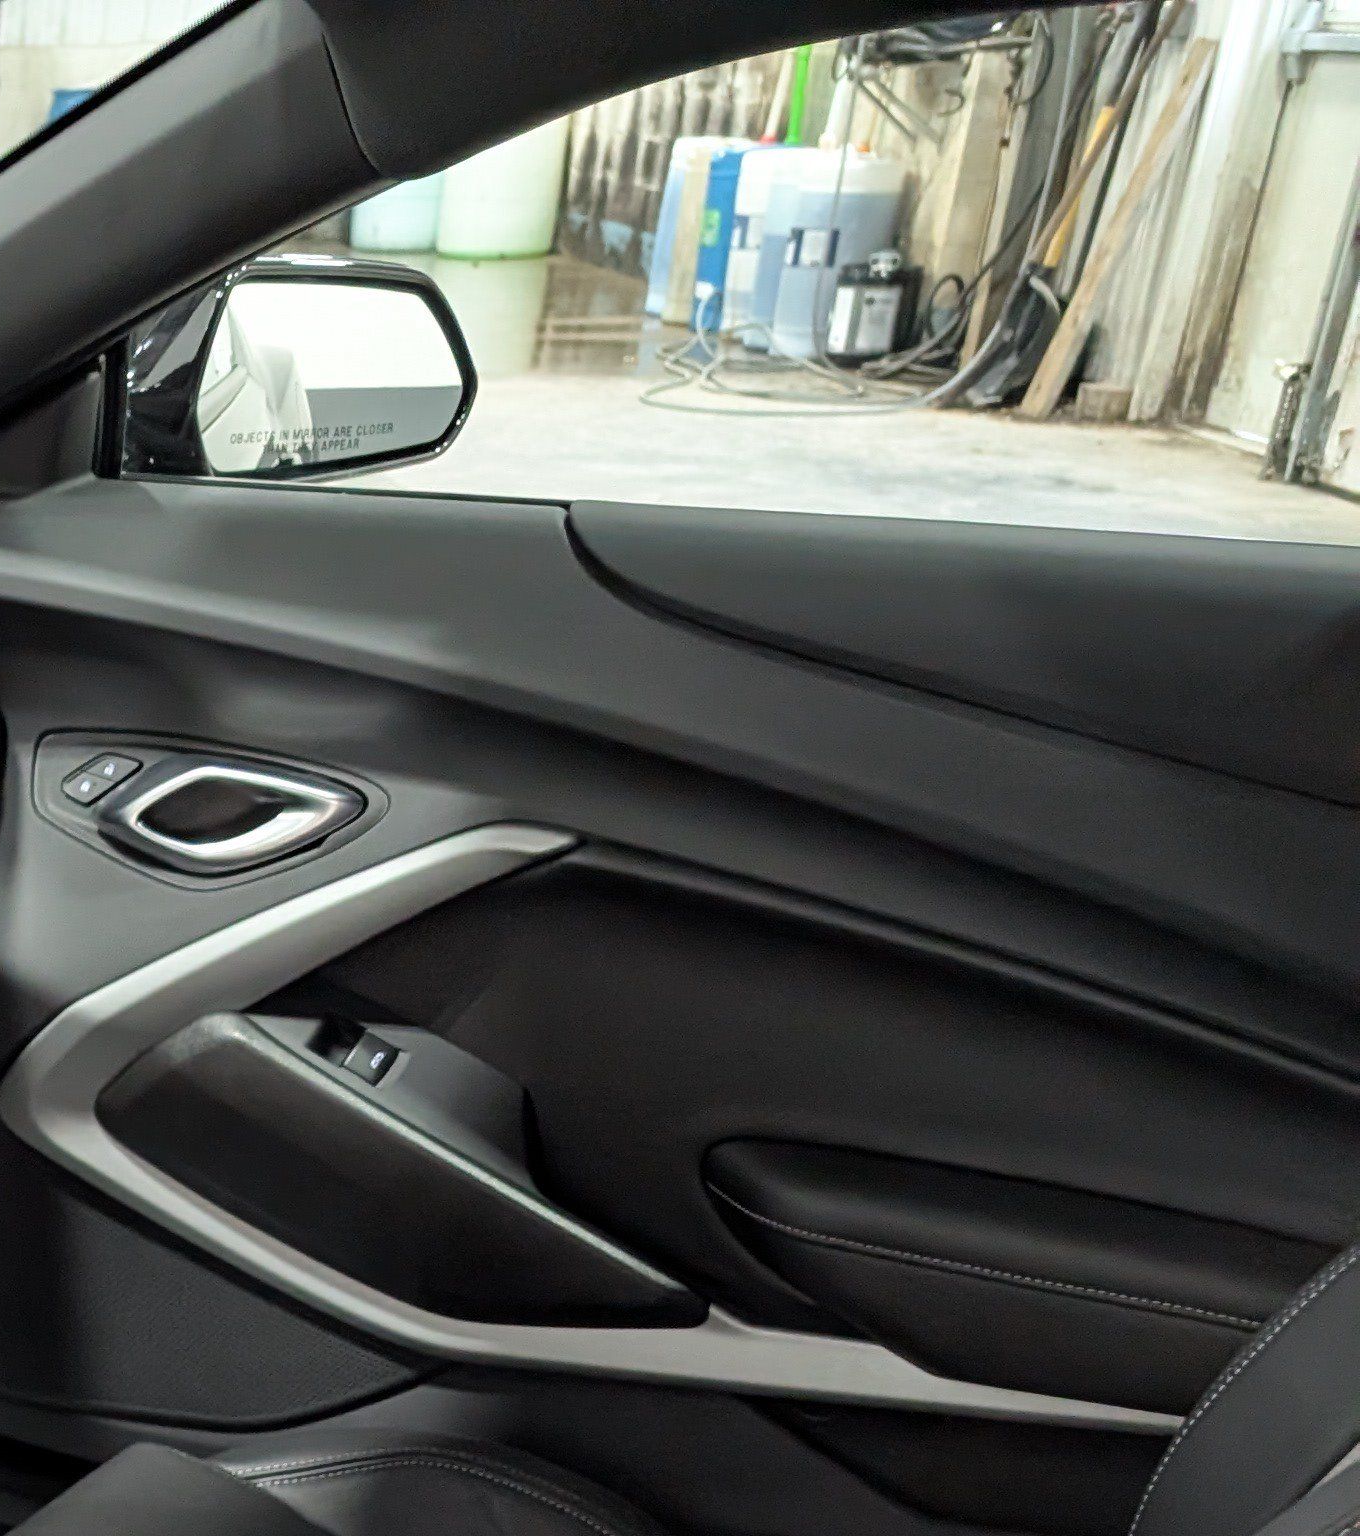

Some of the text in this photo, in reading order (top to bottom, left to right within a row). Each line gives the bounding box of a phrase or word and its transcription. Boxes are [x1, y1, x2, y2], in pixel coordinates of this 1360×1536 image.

[230, 431, 276, 445] OBJECTS
[279, 428, 289, 440] IN
[333, 425, 353, 438] ARE
[356, 422, 394, 436] CLOSER
[321, 438, 360, 451] APPEAR
